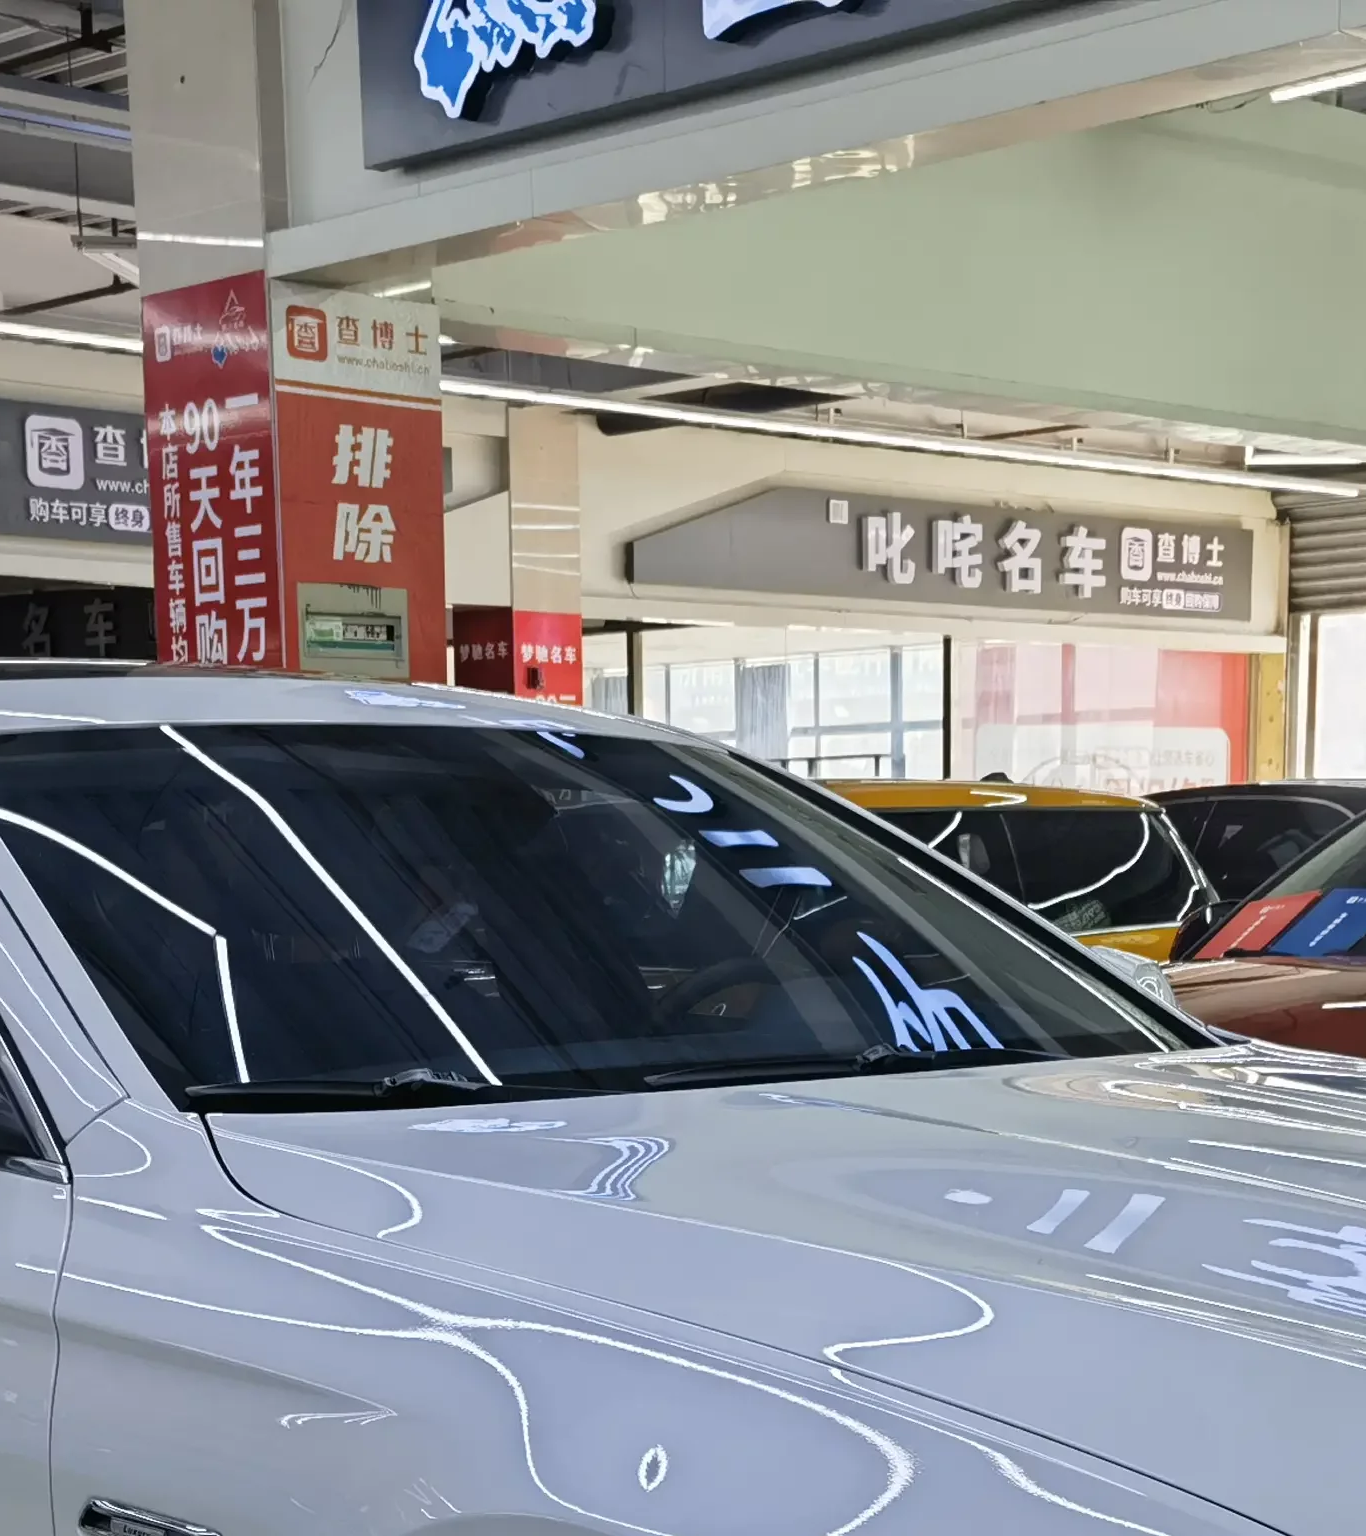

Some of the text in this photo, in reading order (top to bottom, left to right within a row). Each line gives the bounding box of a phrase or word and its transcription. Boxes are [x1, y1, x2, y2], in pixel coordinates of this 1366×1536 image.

[336, 315, 429, 356] 查博士
[93, 424, 149, 469] 查
[331, 423, 397, 564] 排除
[184, 397, 229, 666] 90天回购
[224, 392, 268, 663] 一年三万
[861, 511, 1107, 599] 叱咤名车
[1155, 532, 1225, 567] 查博士
[520, 642, 578, 665] 梦驰名车
